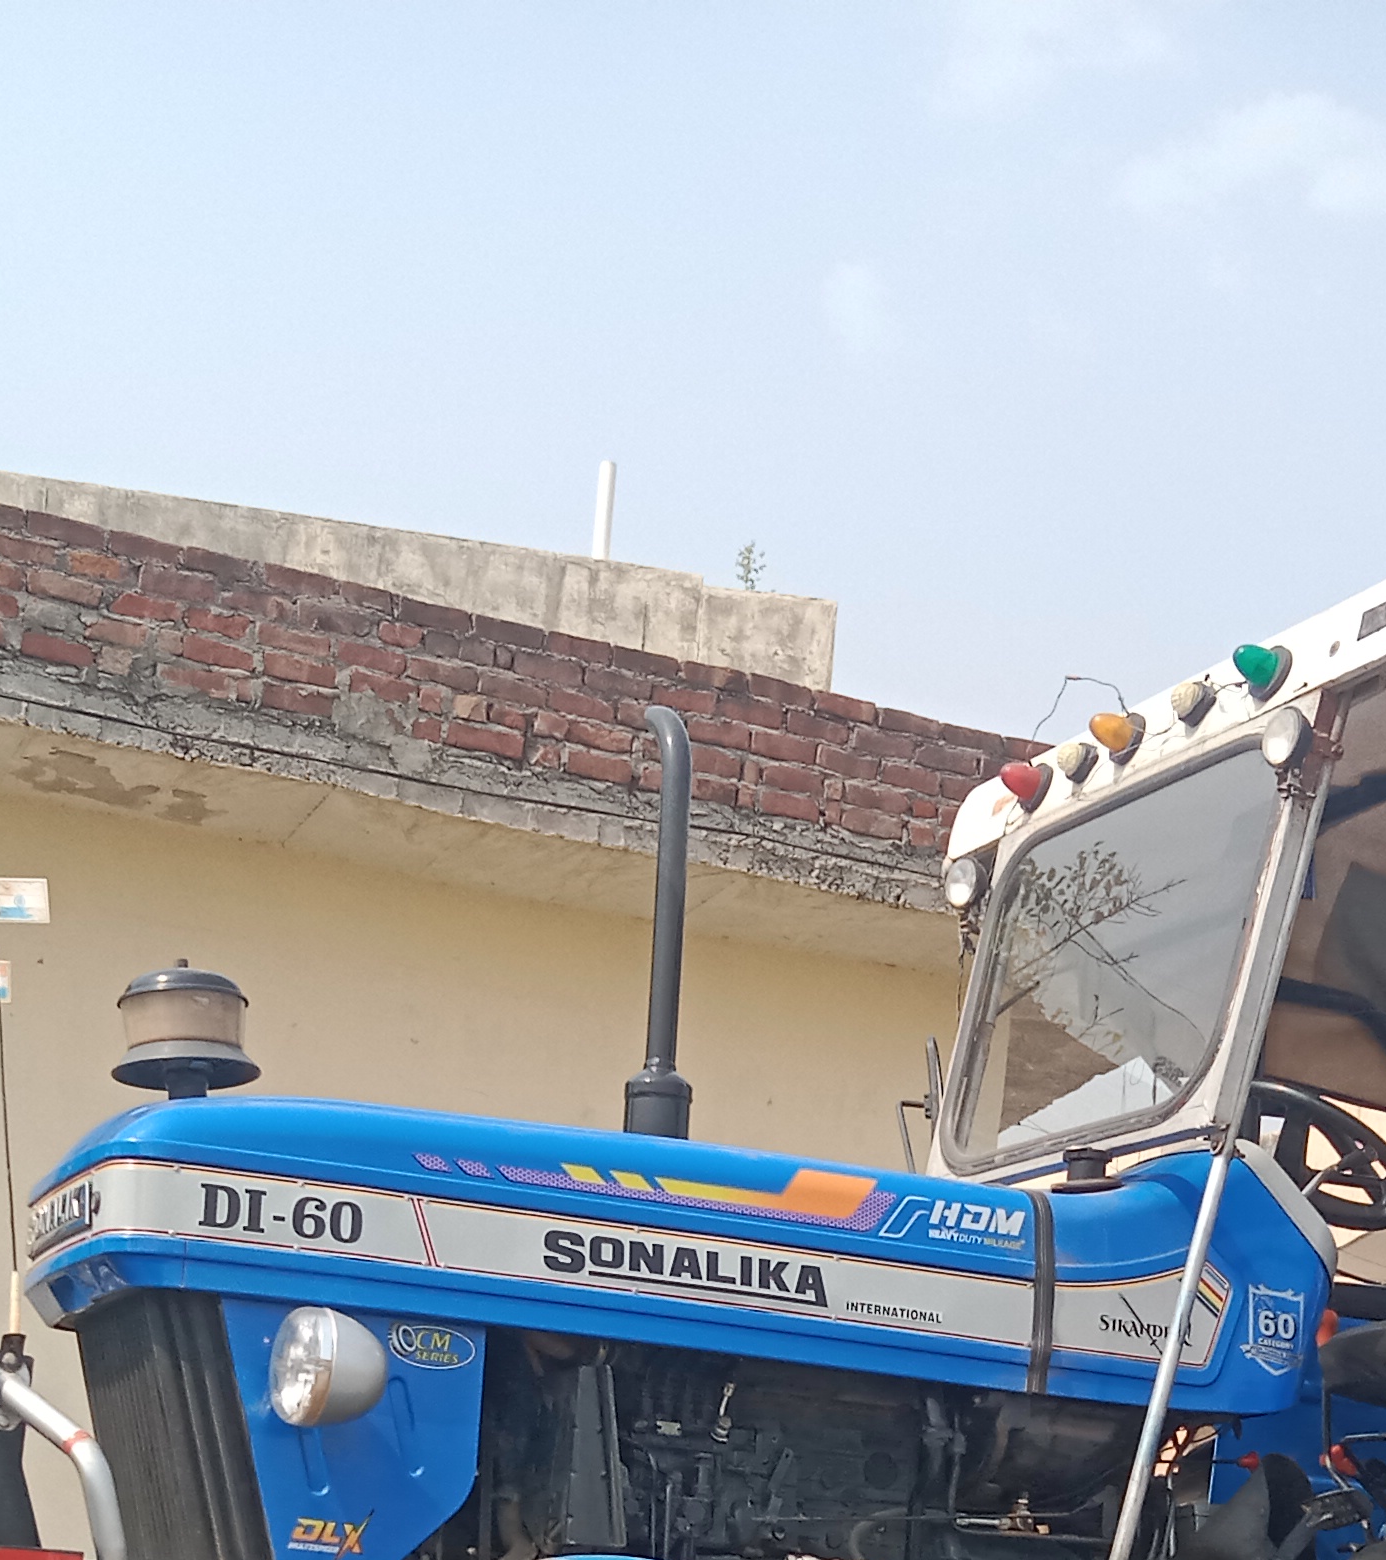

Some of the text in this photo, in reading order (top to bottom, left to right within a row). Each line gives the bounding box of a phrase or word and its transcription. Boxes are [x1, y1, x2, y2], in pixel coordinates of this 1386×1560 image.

[198, 1183, 364, 1244] DI-60
[928, 1199, 1026, 1237] HDM
[959, 1232, 982, 1245] DUTY
[543, 1229, 829, 1308] SONALIKA
[844, 1301, 943, 1324] INTERNATIONAL
[1258, 1309, 1296, 1341] 60
[415, 1350, 459, 1364] SERIES
